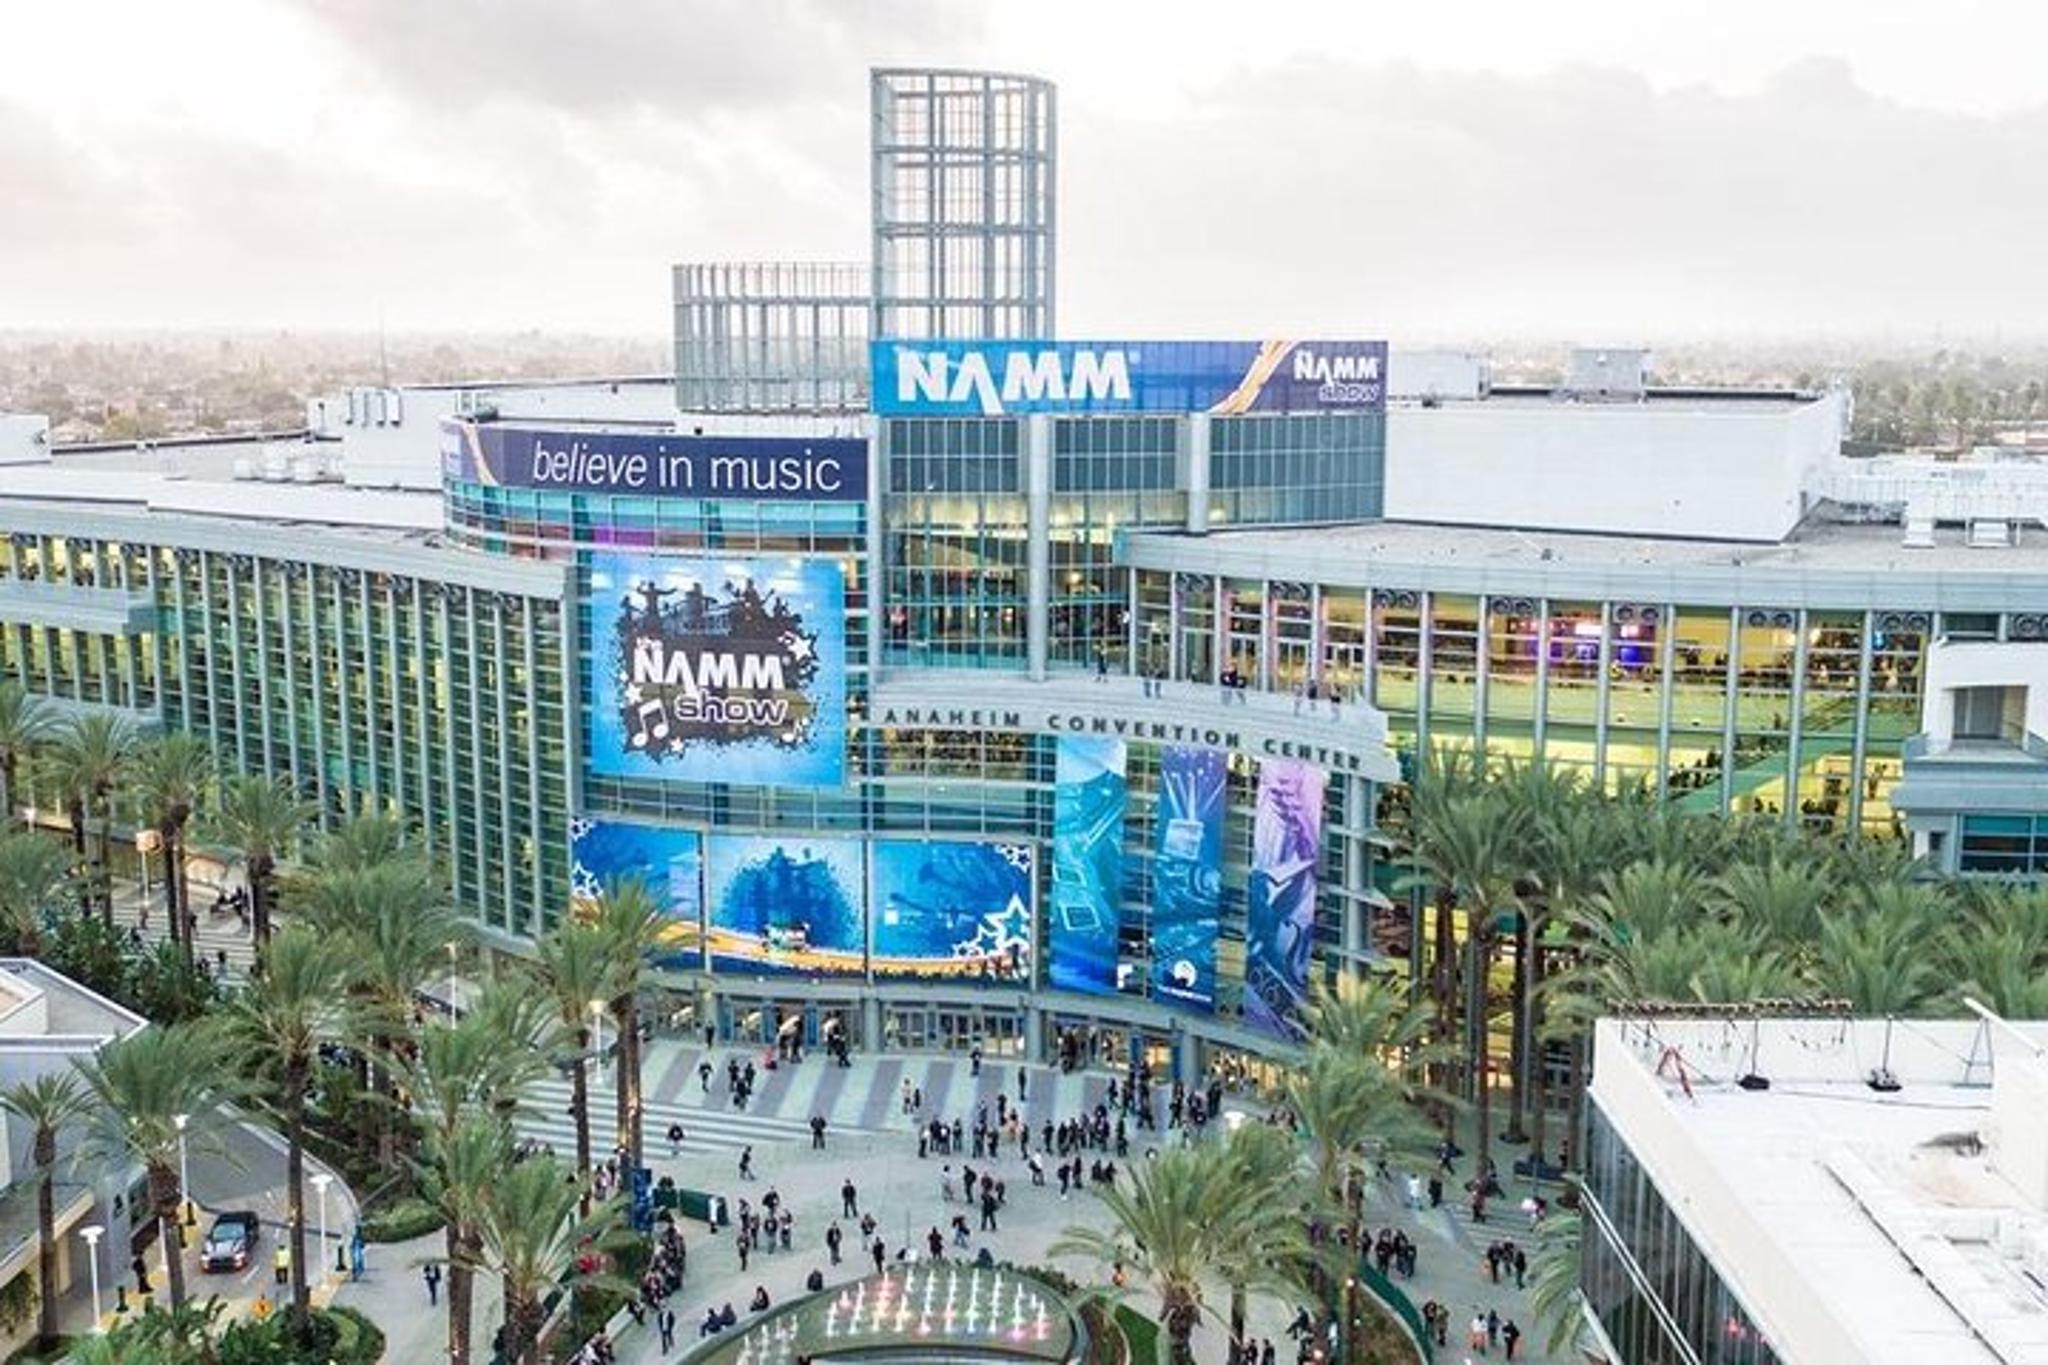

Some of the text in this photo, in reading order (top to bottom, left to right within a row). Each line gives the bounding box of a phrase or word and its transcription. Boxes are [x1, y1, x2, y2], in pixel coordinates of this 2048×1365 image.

[897, 350, 1132, 415] NAMM
[1293, 355, 1379, 386] NAMM
[1318, 380, 1380, 402] show
[532, 440, 841, 491] believe in music
[633, 648, 786, 697] NAMM
[674, 688, 788, 725] show
[884, 708, 1361, 771] ANAHEIM CONVENTION CENTER
